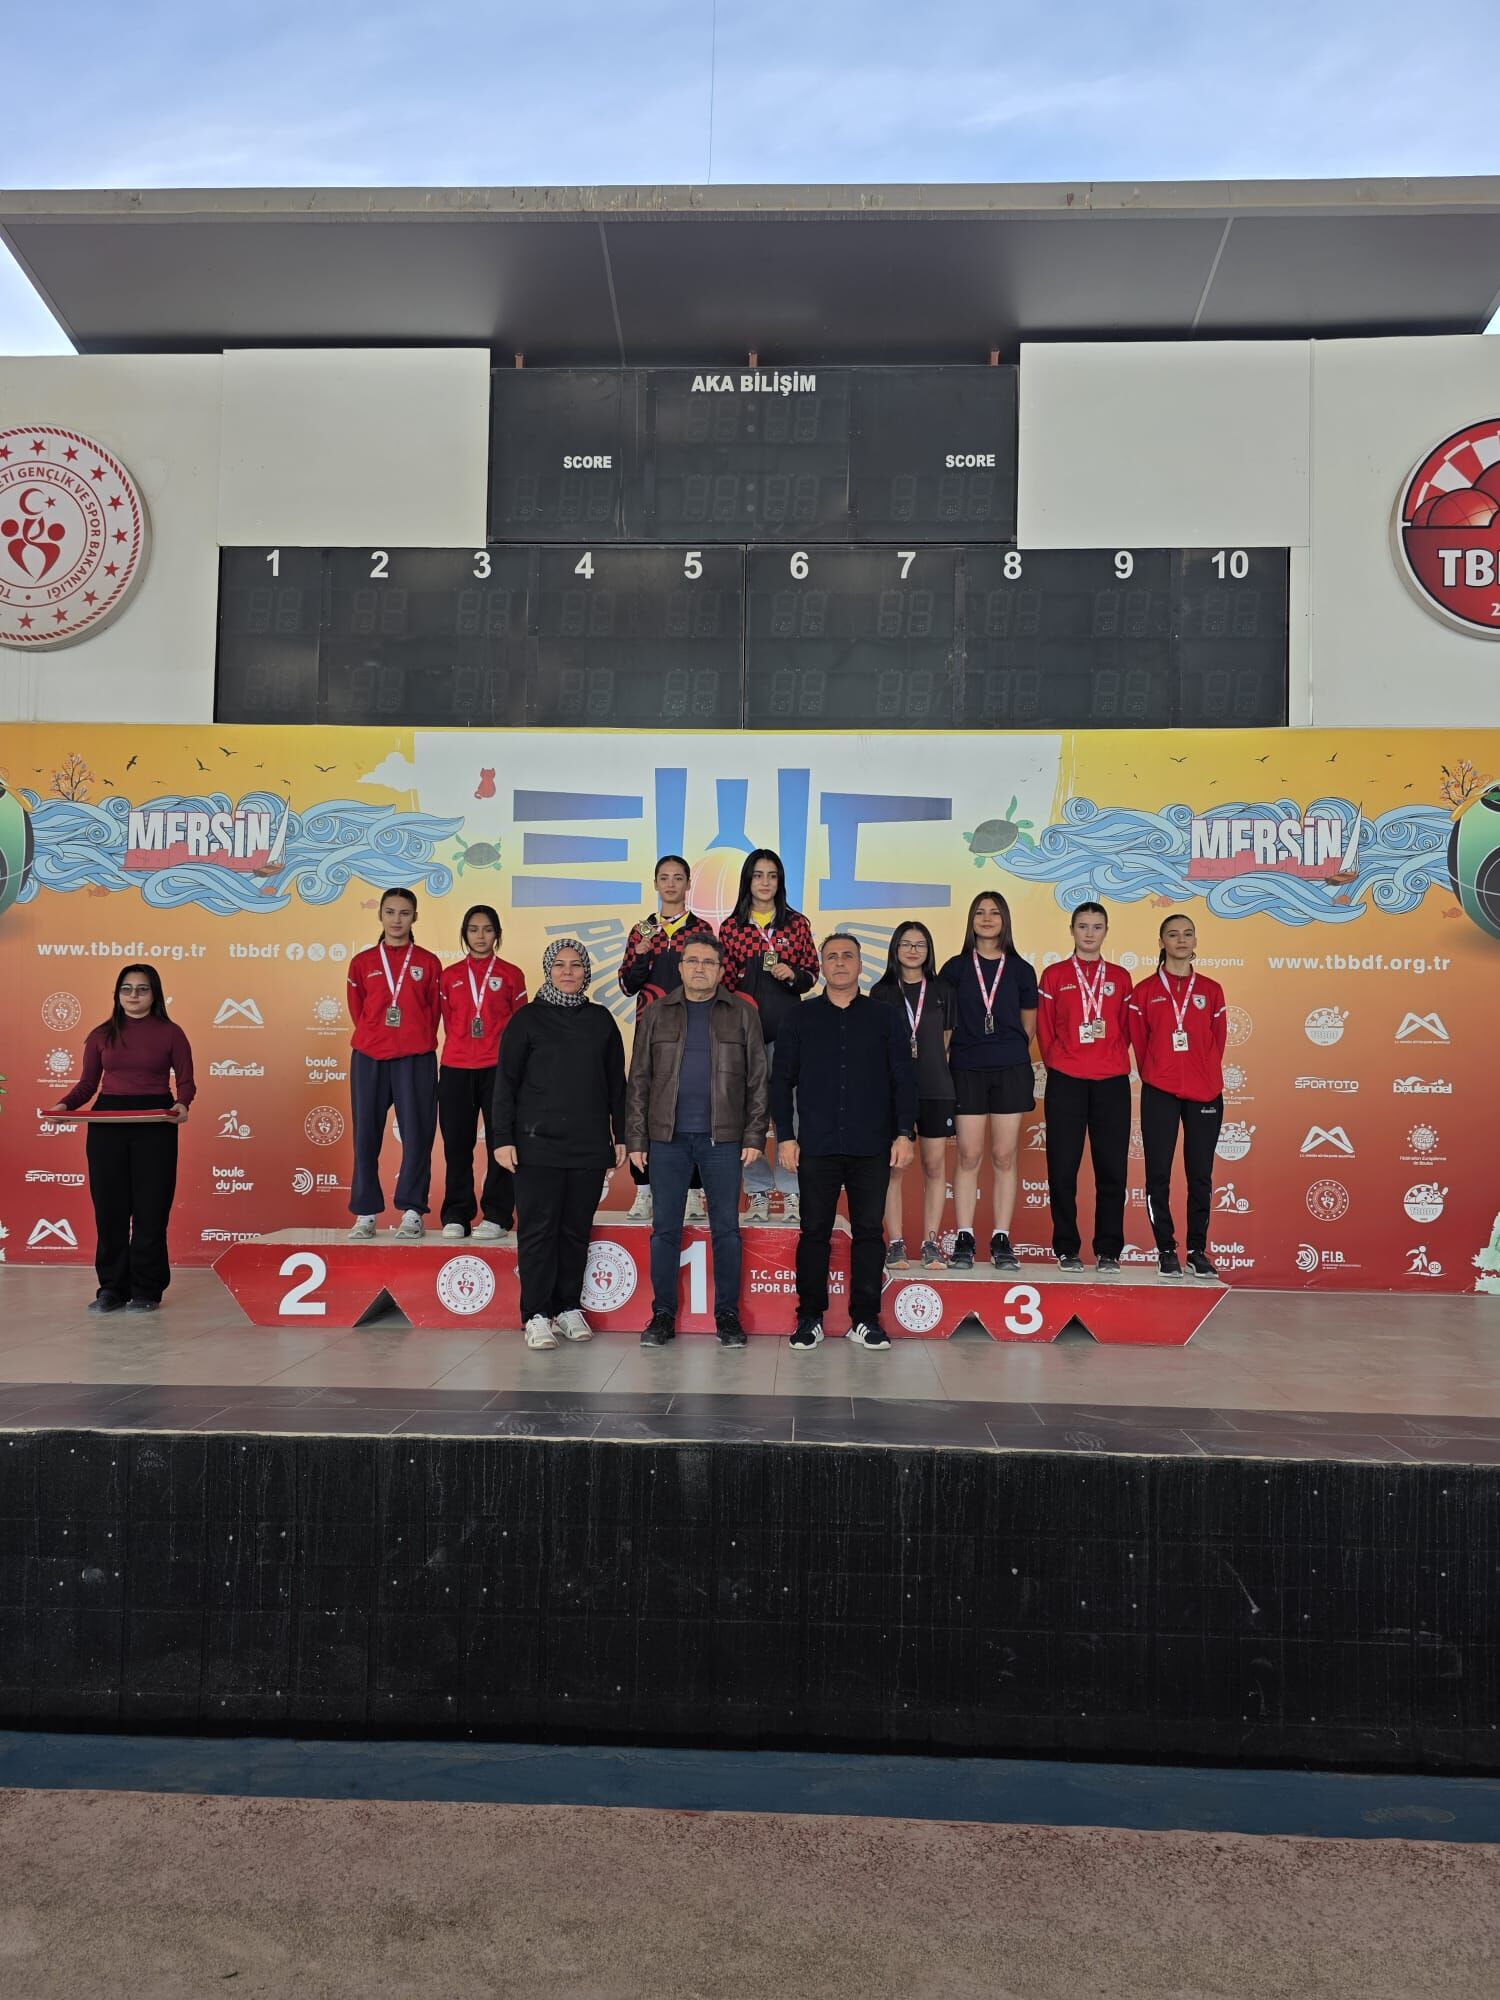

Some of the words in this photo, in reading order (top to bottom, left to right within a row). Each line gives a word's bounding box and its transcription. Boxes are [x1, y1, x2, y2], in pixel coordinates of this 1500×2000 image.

[691, 375, 735, 392] AKA
[741, 371, 816, 395] BİLİŞİM
[563, 456, 612, 469] SCORE
[945, 454, 995, 468] SCORE
[18, 467, 77, 489] GENÇLİK
[74, 484, 90, 501] VE
[84, 501, 101, 537] SPOR
[48, 541, 100, 599] BAKANLIĞI
[266, 550, 280, 577] 1
[370, 551, 389, 578] 2
[472, 552, 491, 578] 3
[575, 552, 594, 578] 4
[684, 552, 702, 578] 5
[790, 552, 809, 579] 6
[898, 552, 916, 578] 7
[1003, 551, 1022, 579] 8
[1114, 551, 1134, 579] 9
[1211, 551, 1249, 579] 10
[1438, 549, 1500, 588] TB
[37, 942, 206, 960] www.tbbdf.org.tr
[229, 943, 280, 957] tbbdf
[1268, 955, 1450, 974] www.tbbdf.org.tr
[305, 1056, 337, 1067] boule
[309, 1069, 323, 1080] du
[324, 1069, 347, 1083] jour
[1295, 1078, 1359, 1091] SPORTOTO
[40, 1122, 54, 1132] du
[55, 1122, 78, 1135] jour
[25, 1172, 85, 1185] SPORTOTO
[212, 1166, 245, 1177] boule
[216, 1180, 230, 1190] du
[230, 1179, 254, 1193] jour
[1023, 1179, 1050, 1191] boul
[1026, 1193, 1041, 1204] du
[1211, 1241, 1245, 1253] boule
[1215, 1255, 1230, 1267] du
[1231, 1254, 1255, 1270] jour
[679, 1241, 707, 1314] 1
[750, 1270, 771, 1281] T.C.
[829, 1271, 844, 1281] VE
[278, 1252, 327, 1315] 2
[750, 1283, 780, 1294] SPOR
[1003, 1285, 1043, 1334] 3
